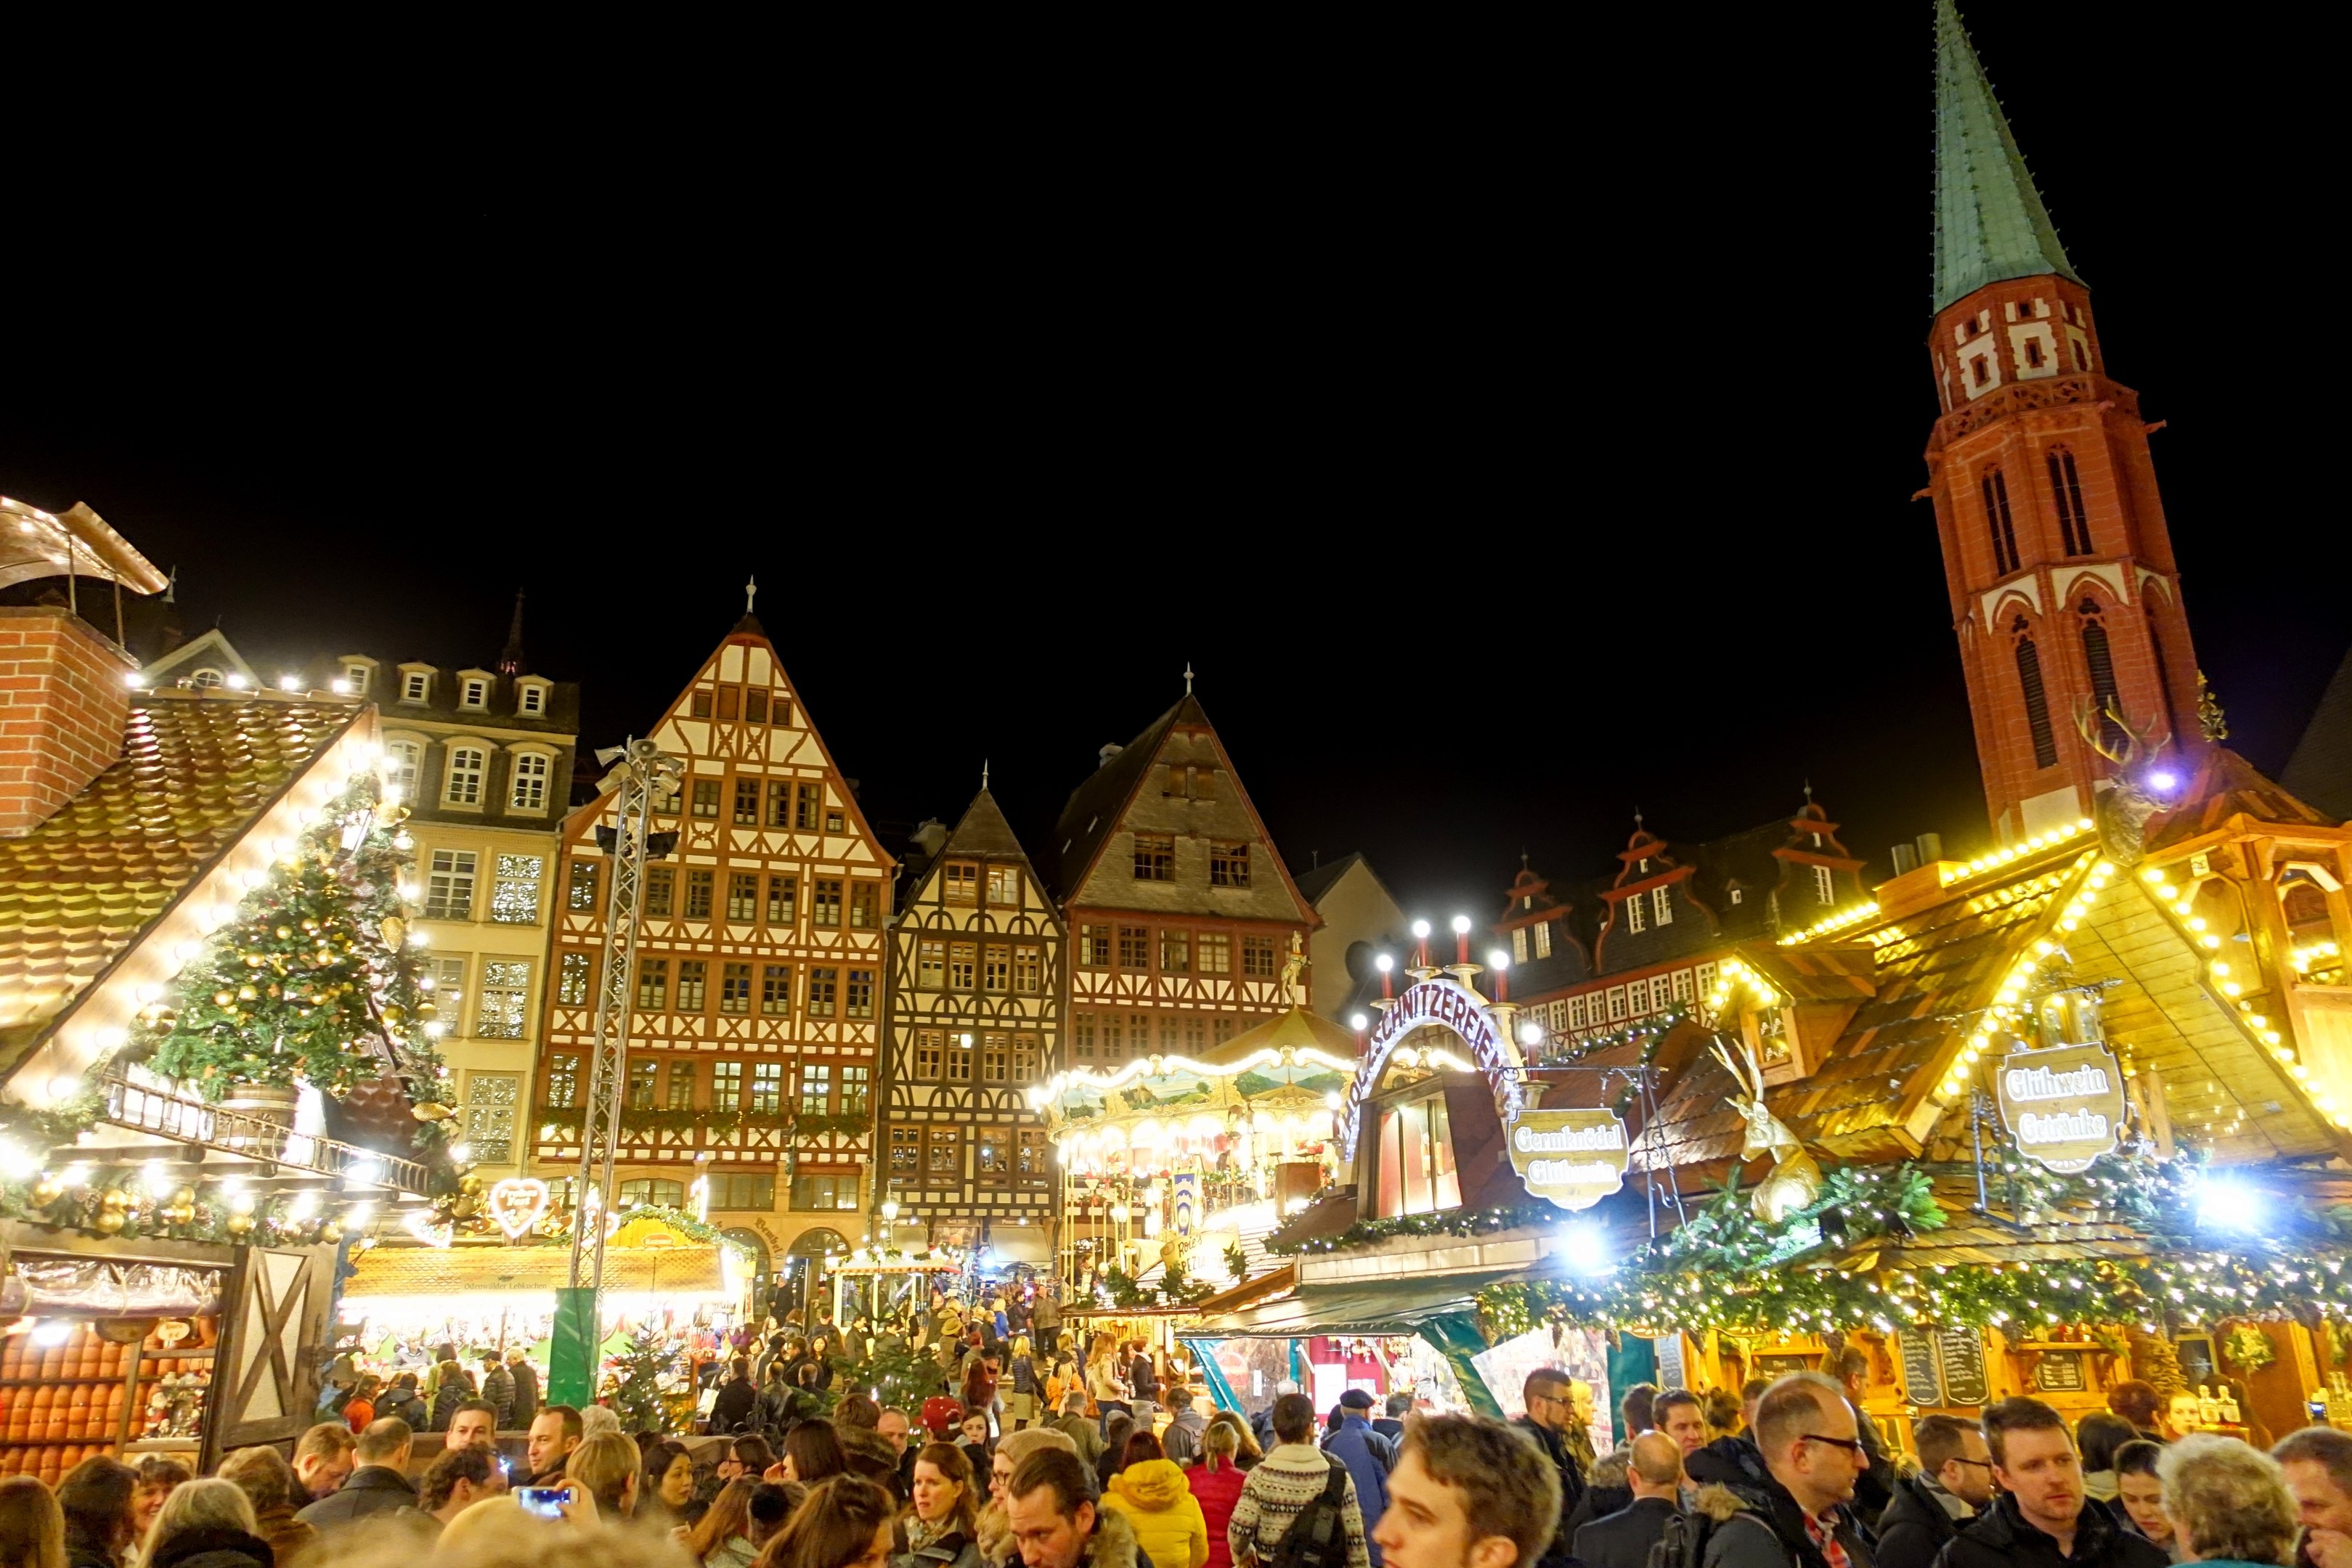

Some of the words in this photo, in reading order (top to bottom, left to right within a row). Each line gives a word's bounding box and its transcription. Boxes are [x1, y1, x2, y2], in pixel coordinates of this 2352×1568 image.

[2006, 1064, 2109, 1102] Glühwein
[1515, 1124, 1623, 1152] Germknödel
[2019, 1107, 2108, 1144] Getränke
[1528, 1159, 1617, 1185] Glühwein
[499, 1187, 539, 1199] Frohes
[506, 1196, 531, 1206] Fest
[509, 1281, 547, 1290] Lebkuchen
